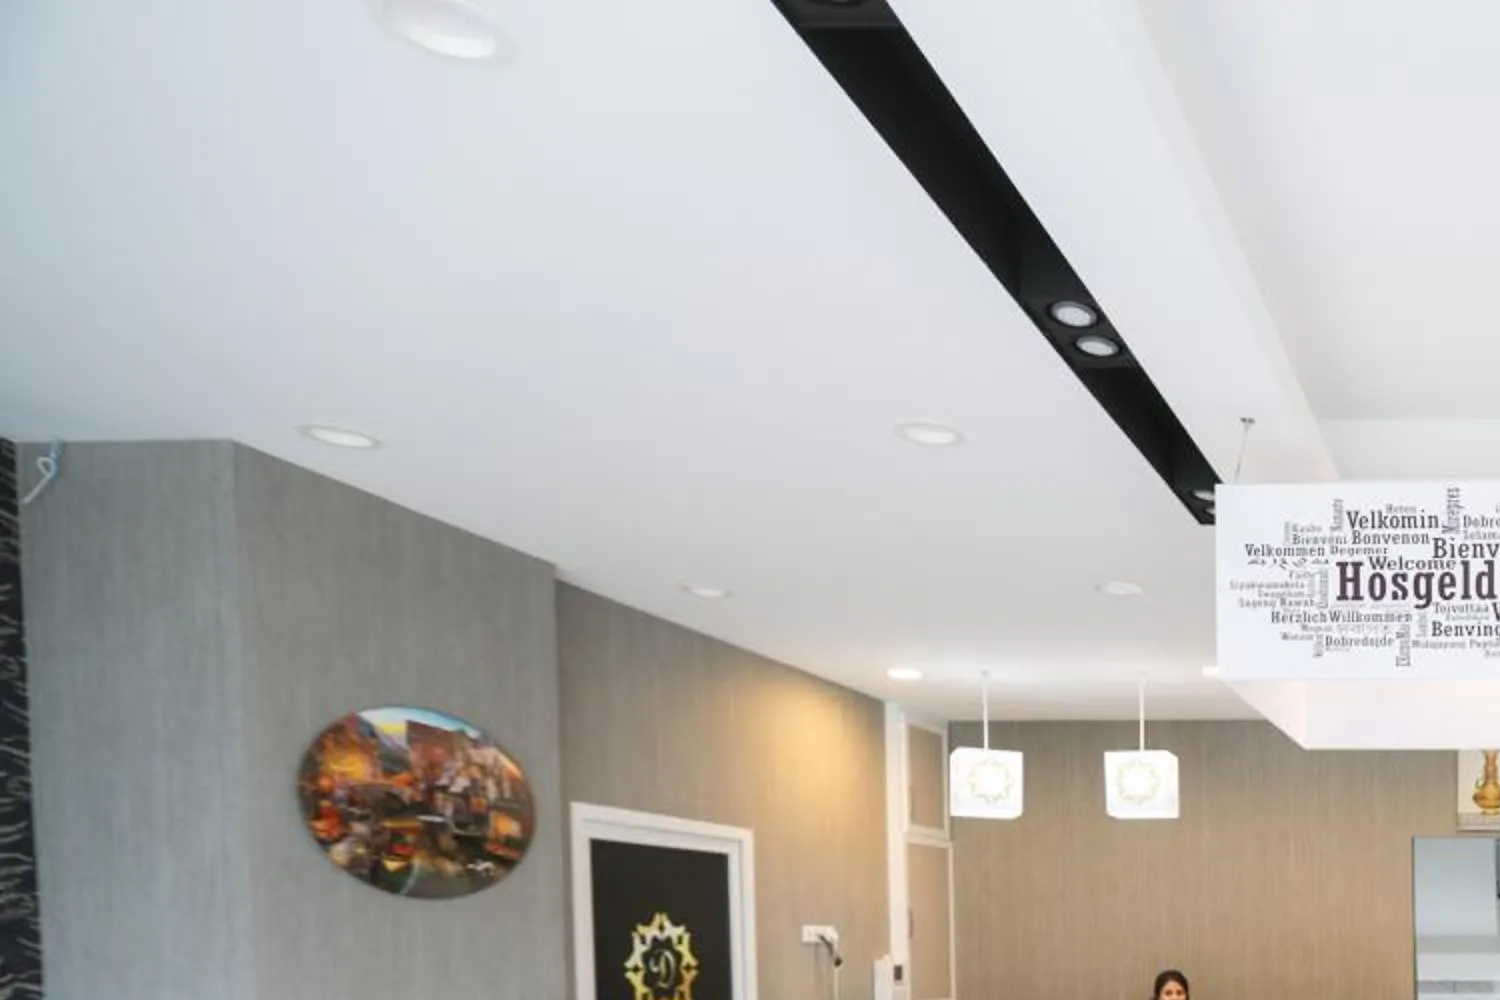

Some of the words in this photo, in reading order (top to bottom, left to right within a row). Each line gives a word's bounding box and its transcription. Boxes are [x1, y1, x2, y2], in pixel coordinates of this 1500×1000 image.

[1346, 509, 1439, 529] Velkomin
[1352, 530, 1430, 545] Bonvenon
[1245, 544, 1325, 557] Velkommen
[1369, 556, 1457, 570] Welcome
[1271, 611, 1327, 623] Herzlich
[1328, 611, 1413, 623] Willkommen
